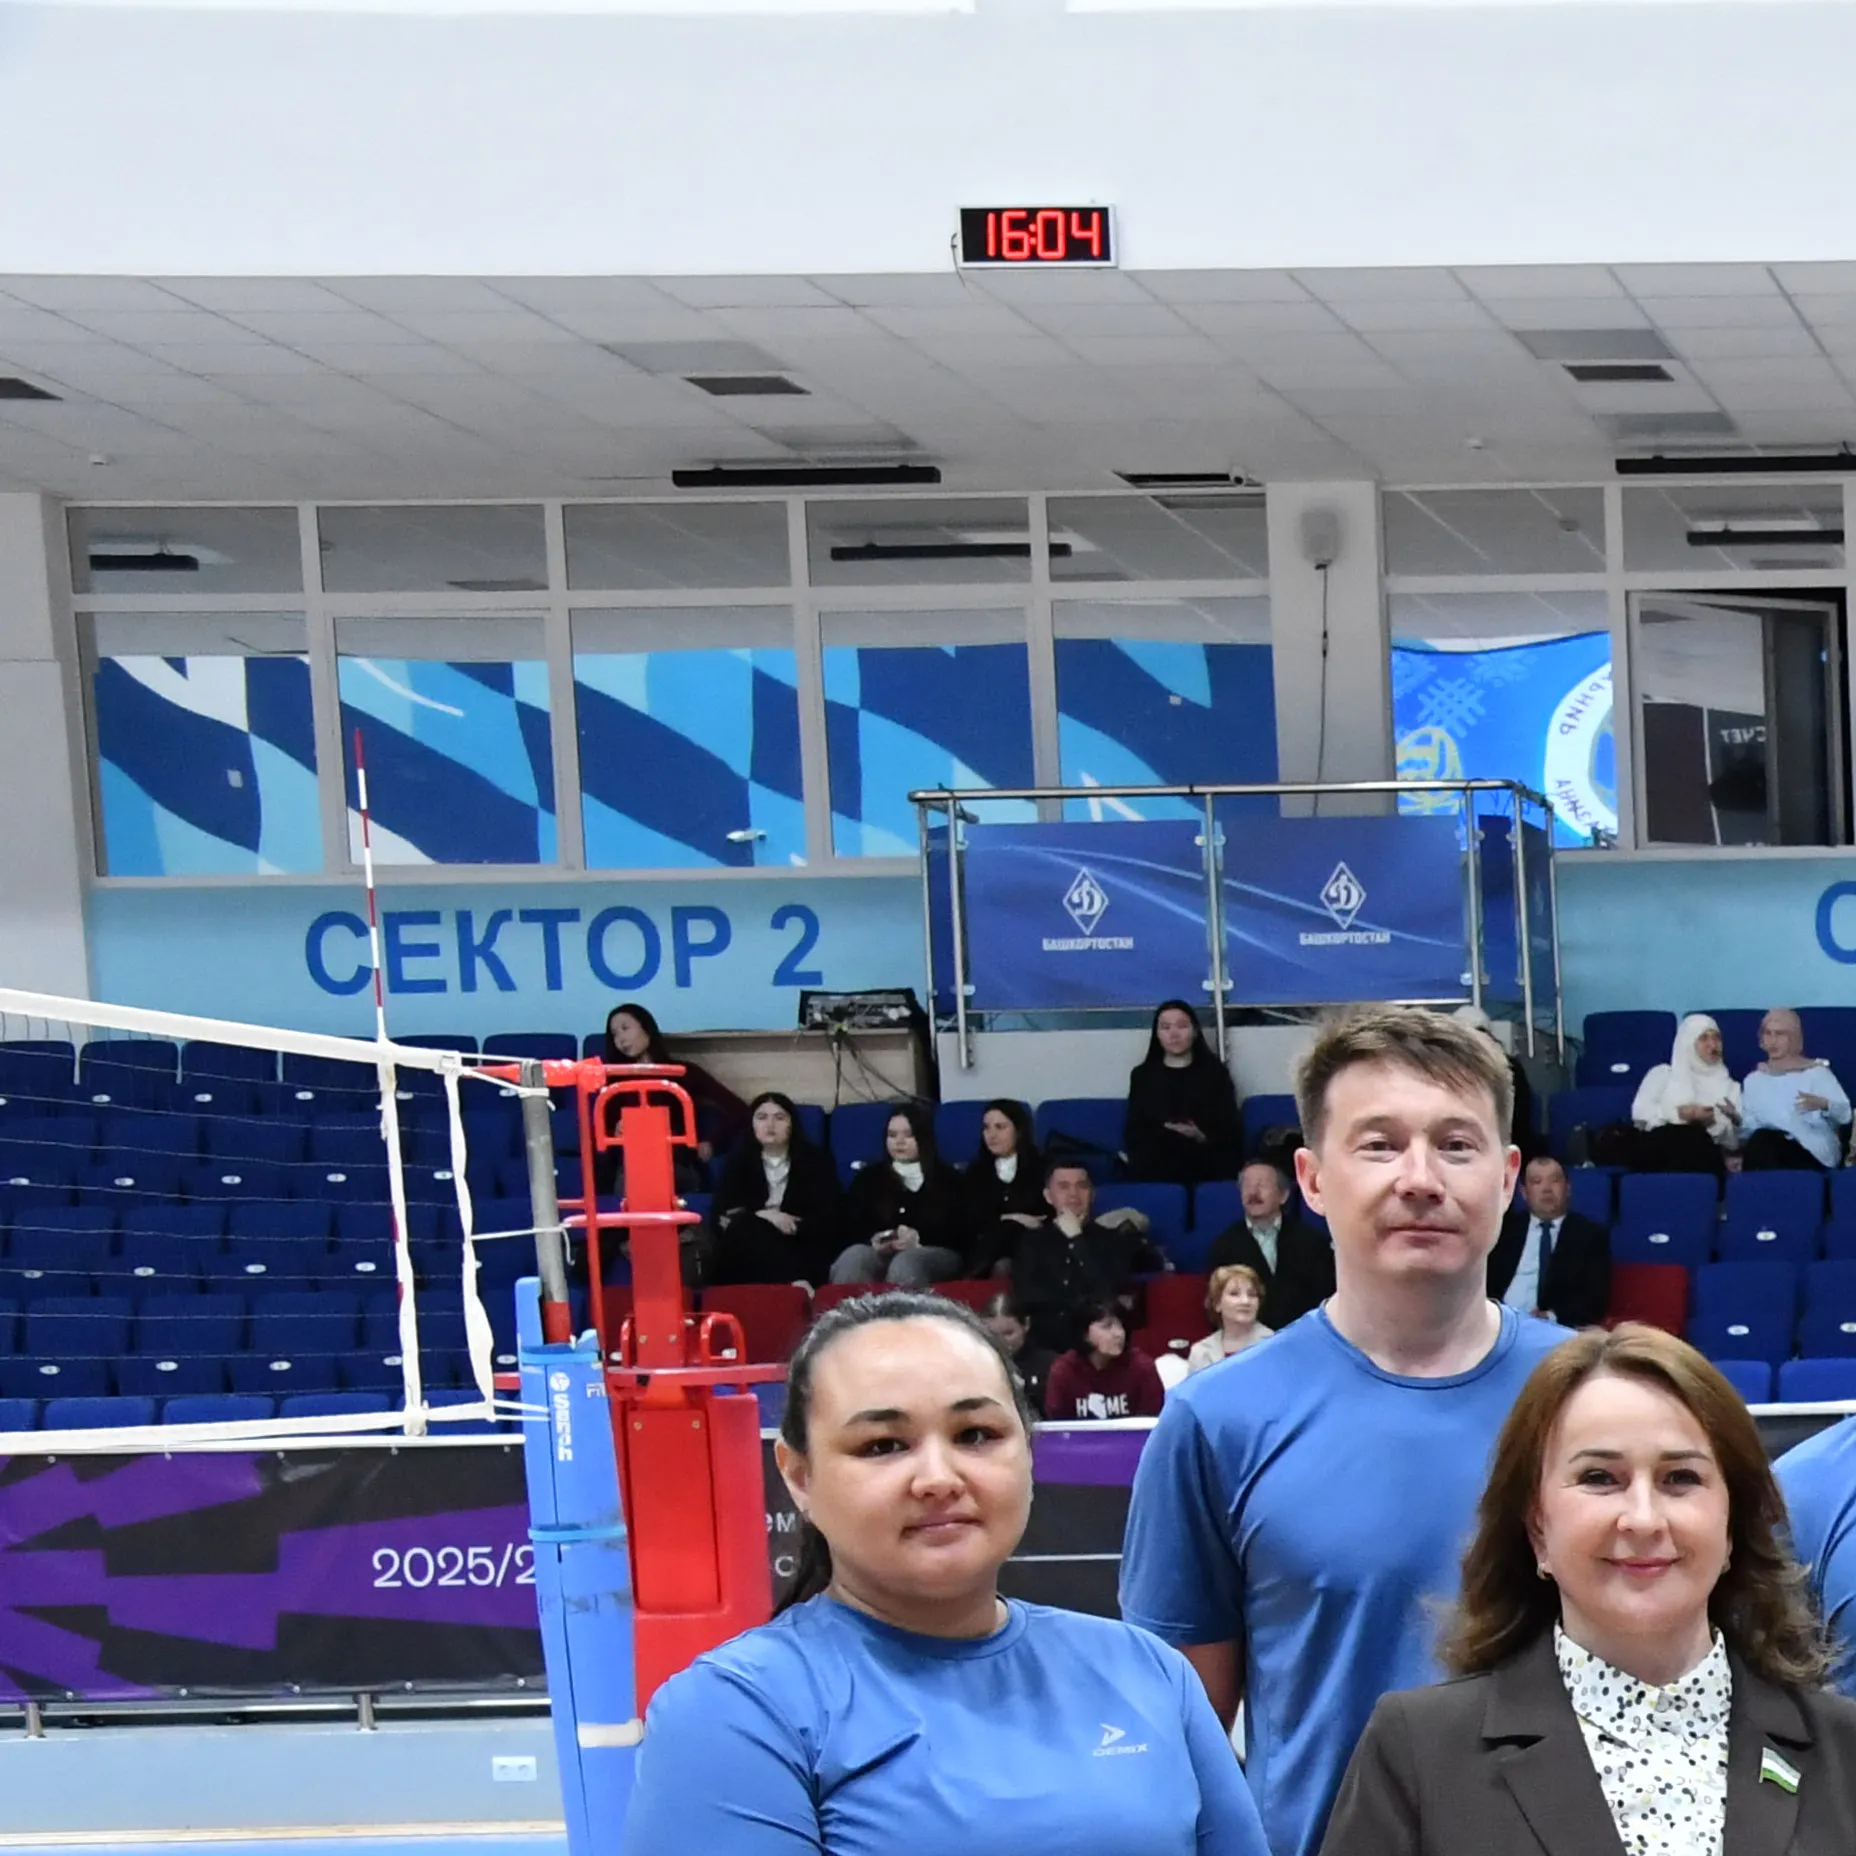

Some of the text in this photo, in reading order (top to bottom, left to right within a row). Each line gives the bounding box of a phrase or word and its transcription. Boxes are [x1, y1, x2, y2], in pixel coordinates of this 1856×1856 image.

[987, 210, 1101, 260] 16:04
[304, 903, 824, 996] СЕКТОР 2
